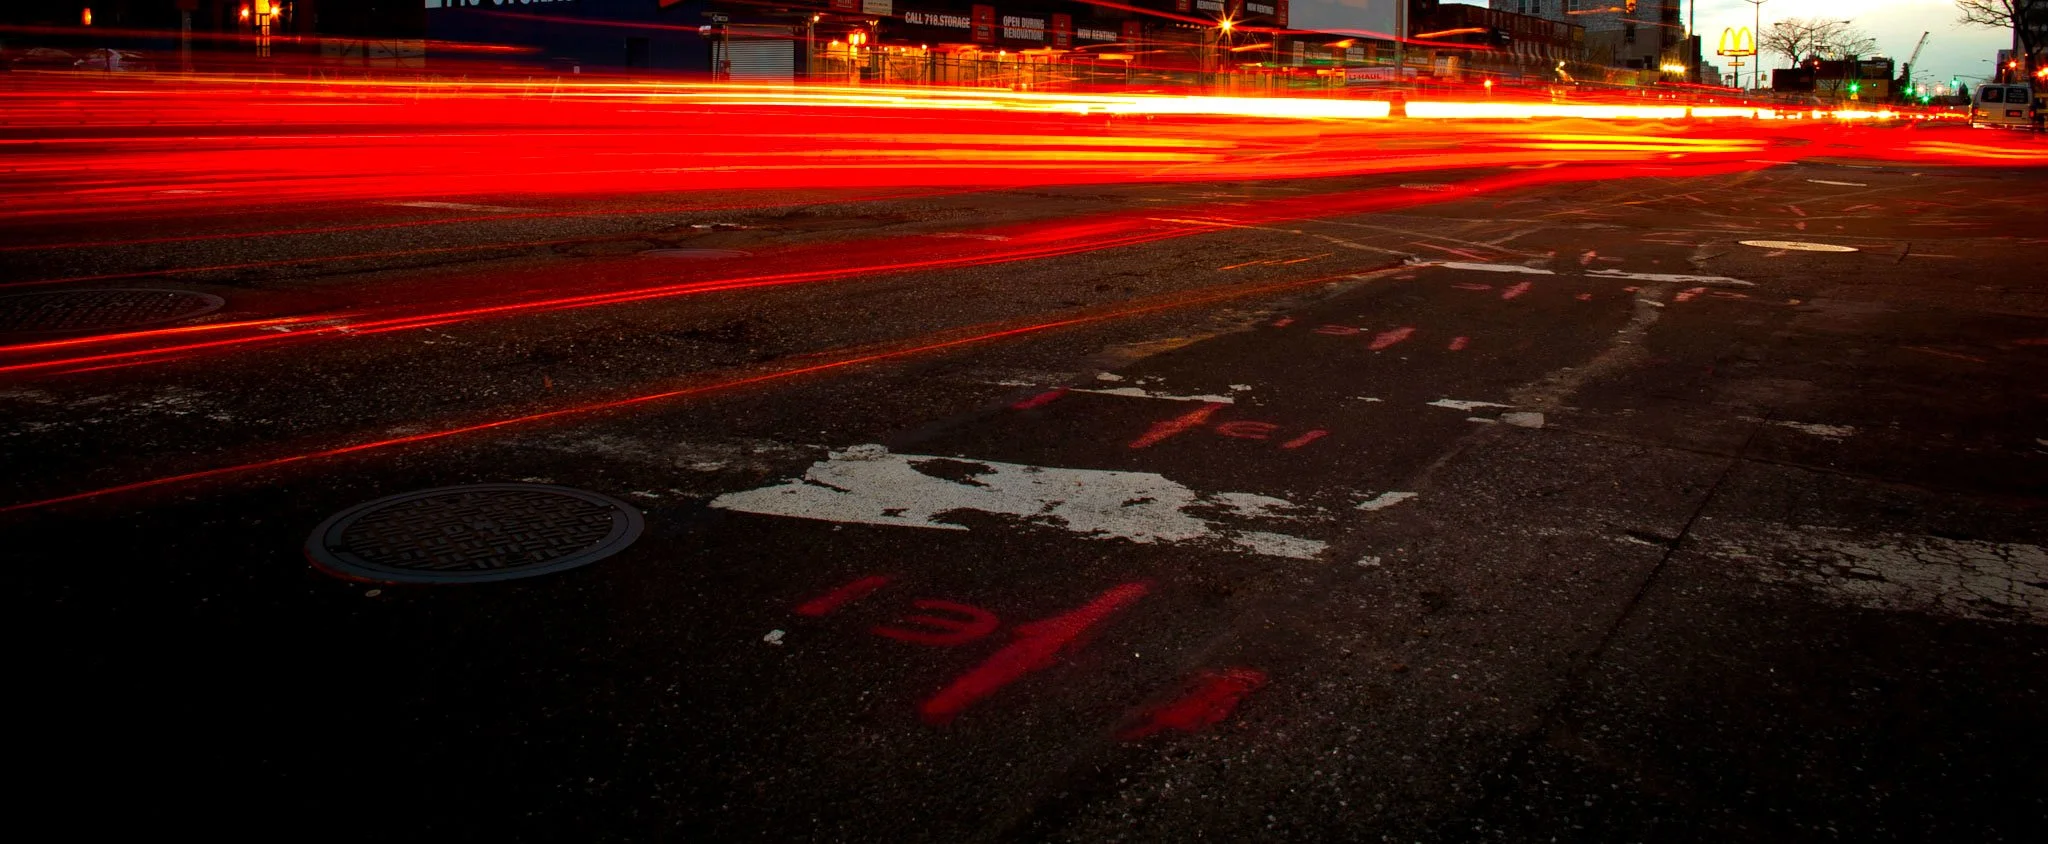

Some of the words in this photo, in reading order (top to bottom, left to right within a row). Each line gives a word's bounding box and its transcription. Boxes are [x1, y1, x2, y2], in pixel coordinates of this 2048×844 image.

[905, 11, 923, 24] CALL
[924, 13, 971, 29] 718.STORAGE
[1003, 15, 1020, 27] OPEN
[1021, 17, 1045, 29] DURING
[1003, 27, 1044, 40] RENOVATION!
[1078, 28, 1091, 39] NOW
